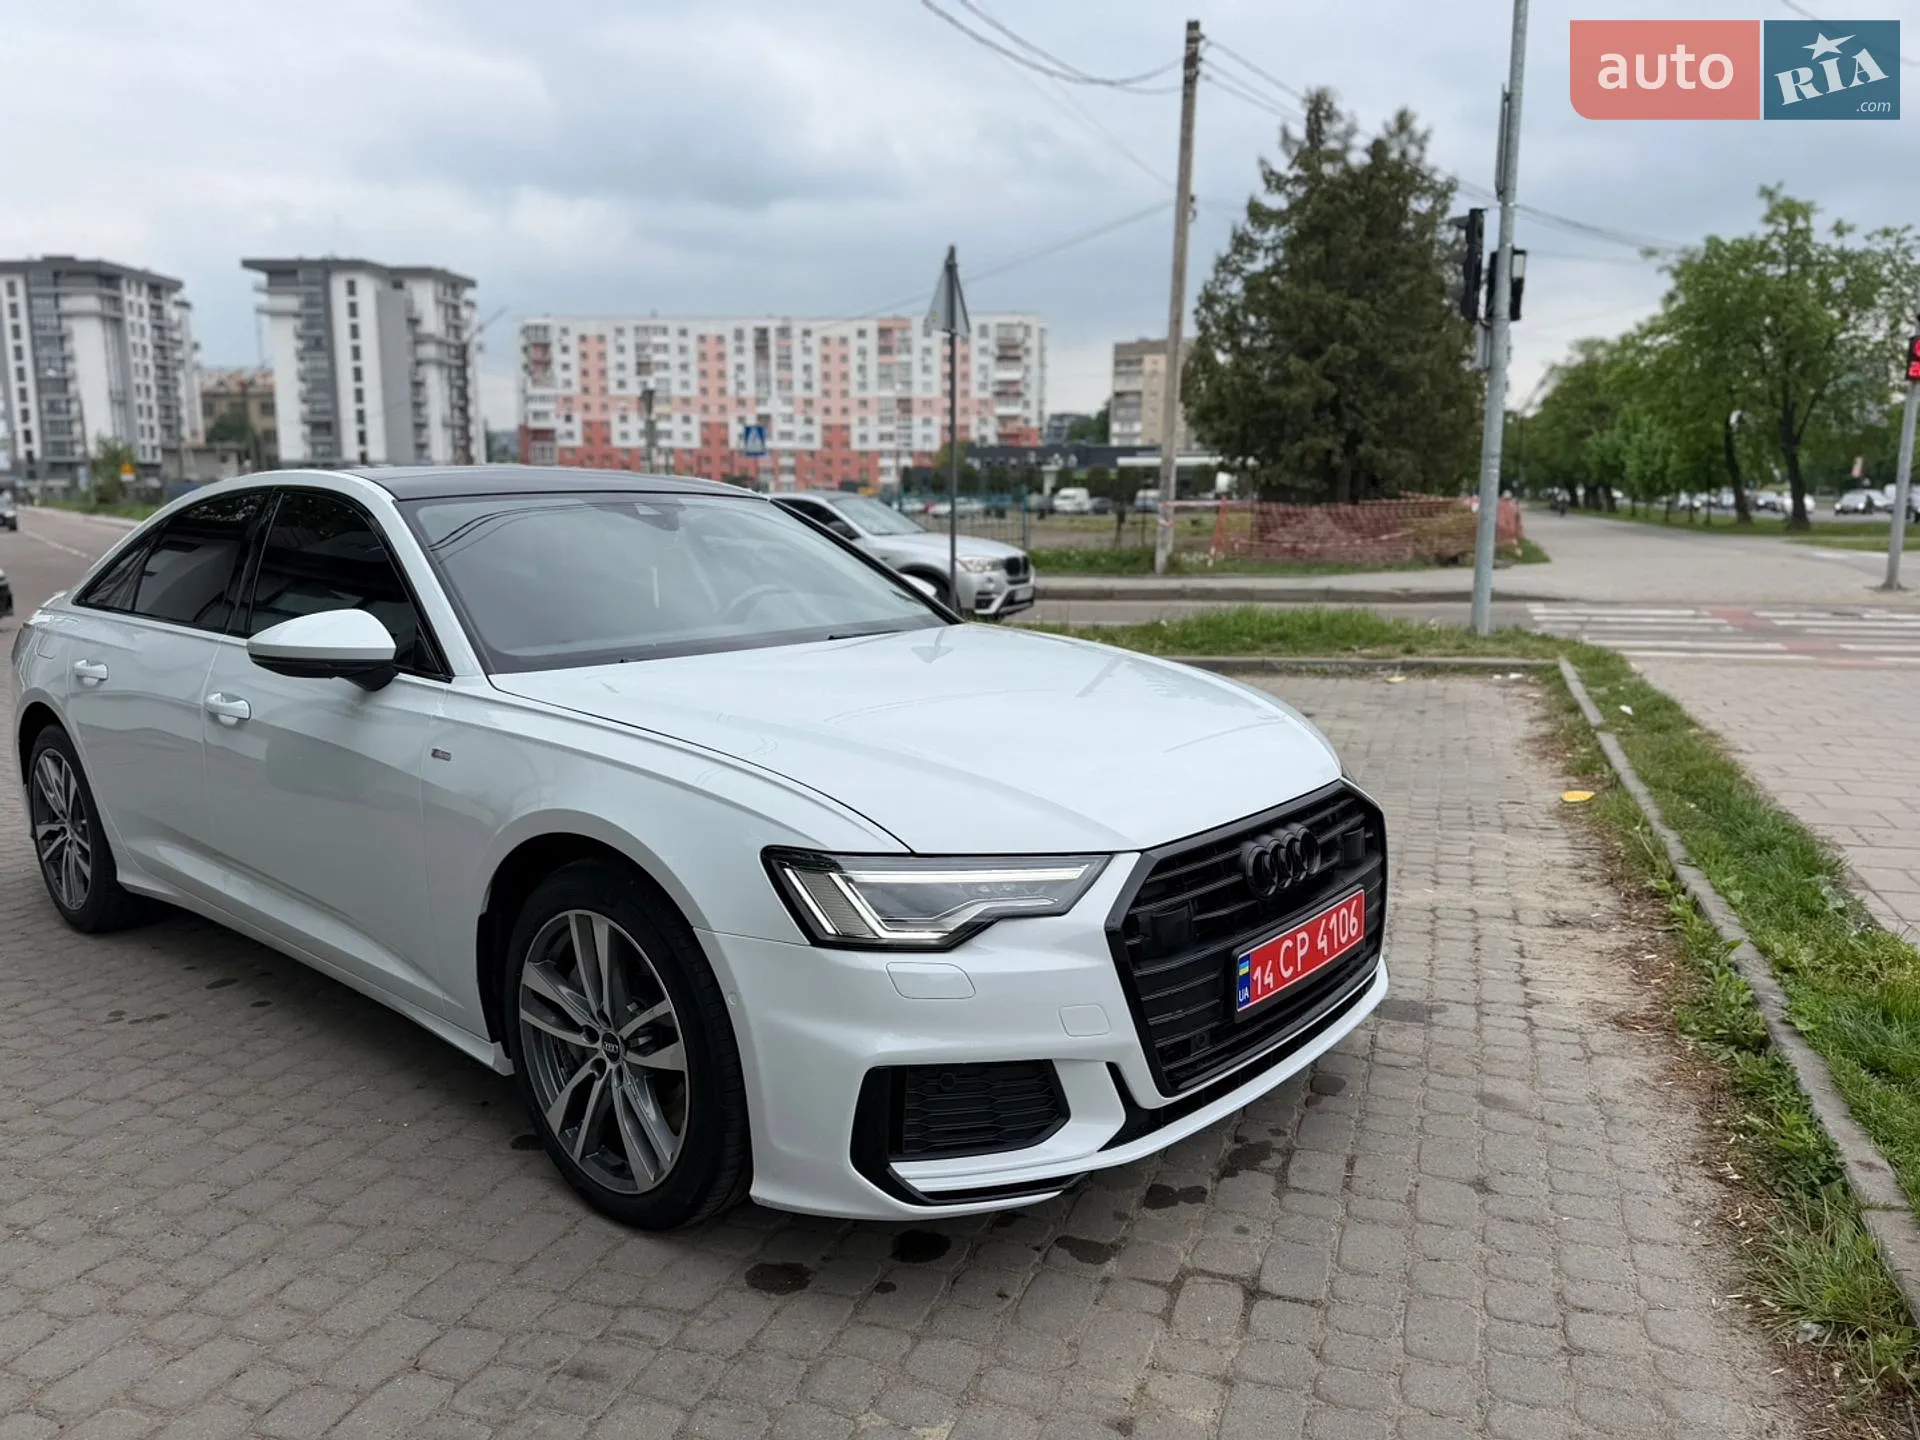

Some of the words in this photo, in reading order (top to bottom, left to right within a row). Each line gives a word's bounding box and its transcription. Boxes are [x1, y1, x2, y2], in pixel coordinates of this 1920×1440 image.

[1252, 960, 1274, 995] 14
[1280, 931, 1309, 978] CP
[1317, 899, 1359, 956] 4106
[1238, 986, 1250, 1002] UA
